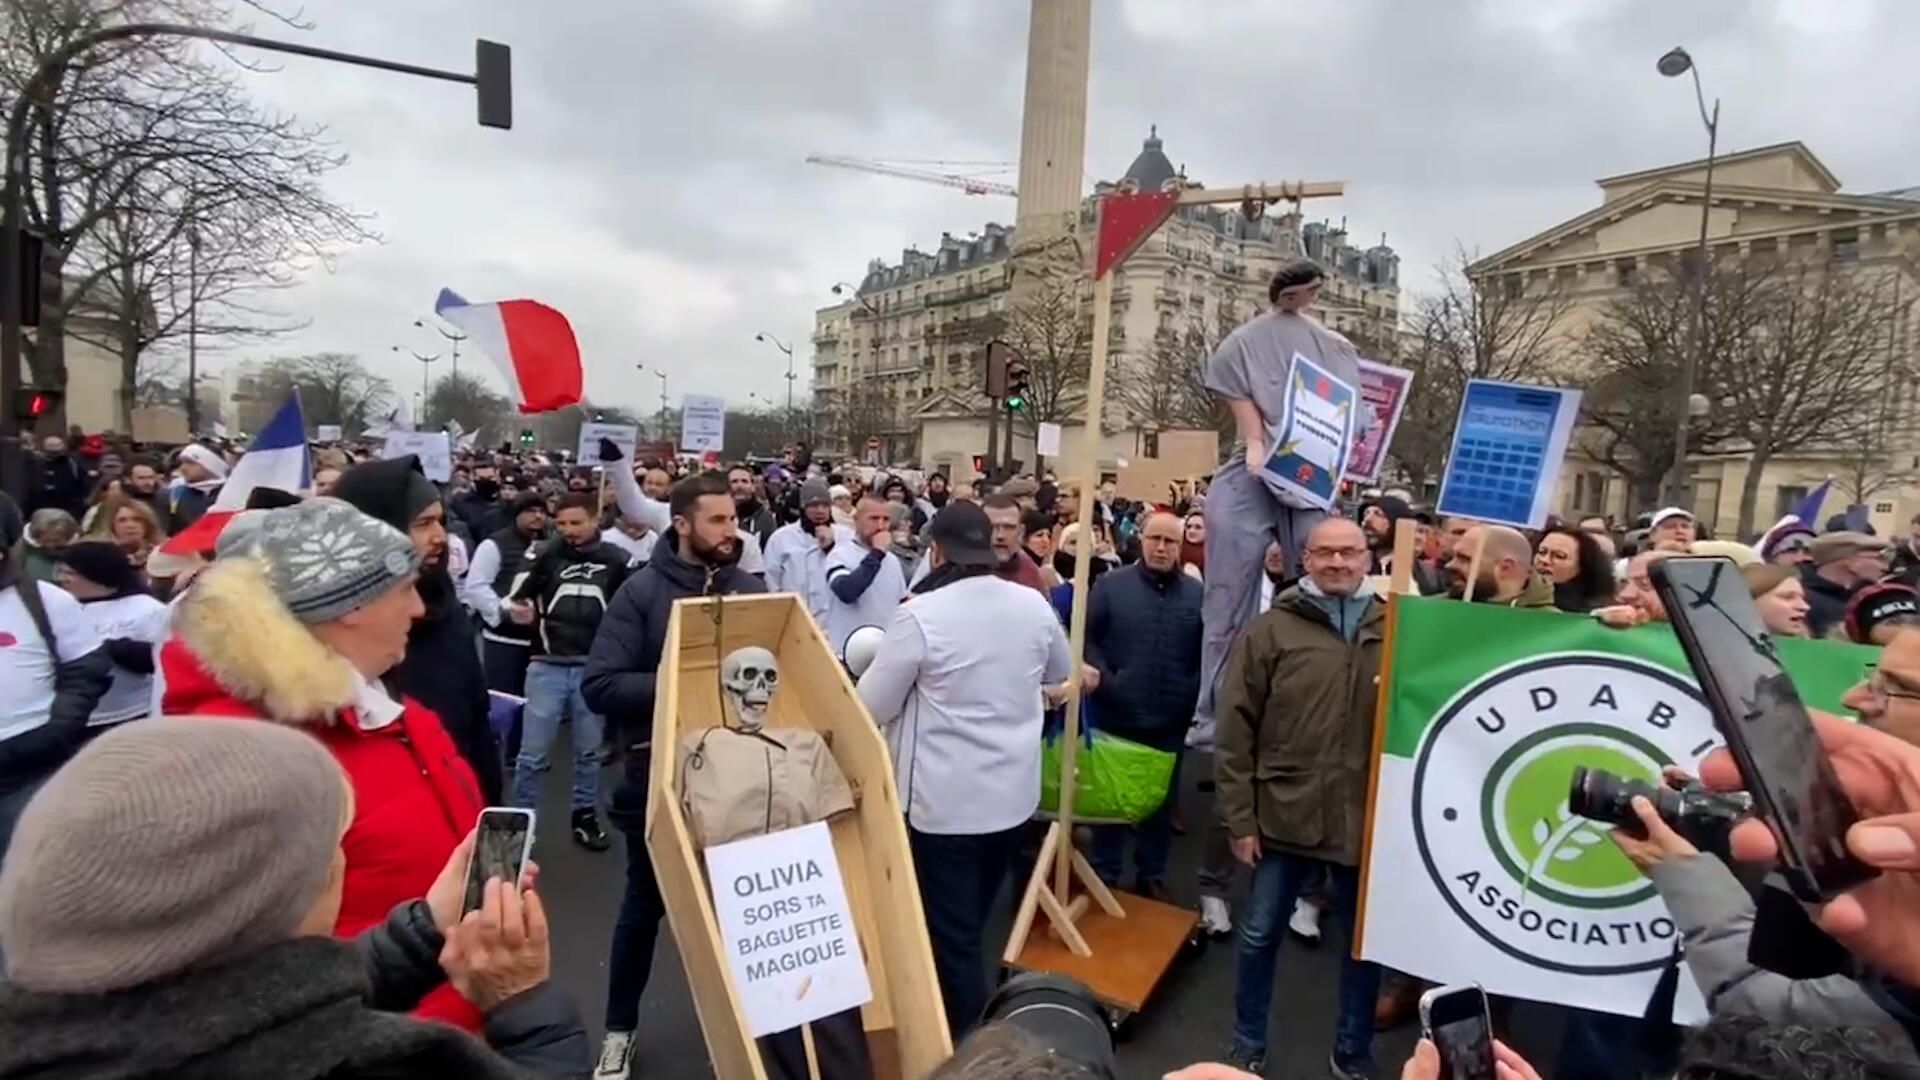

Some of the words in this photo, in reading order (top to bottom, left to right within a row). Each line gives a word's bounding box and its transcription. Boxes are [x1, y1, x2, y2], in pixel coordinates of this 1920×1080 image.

[733, 859, 823, 897] OLIVIA
[744, 897, 802, 926] SORS
[806, 893, 826, 909] TA
[1456, 870, 1678, 945] ASSOCIATIO
[738, 913, 842, 956] BAGUETTE
[746, 938, 846, 982] MAGIQUE
